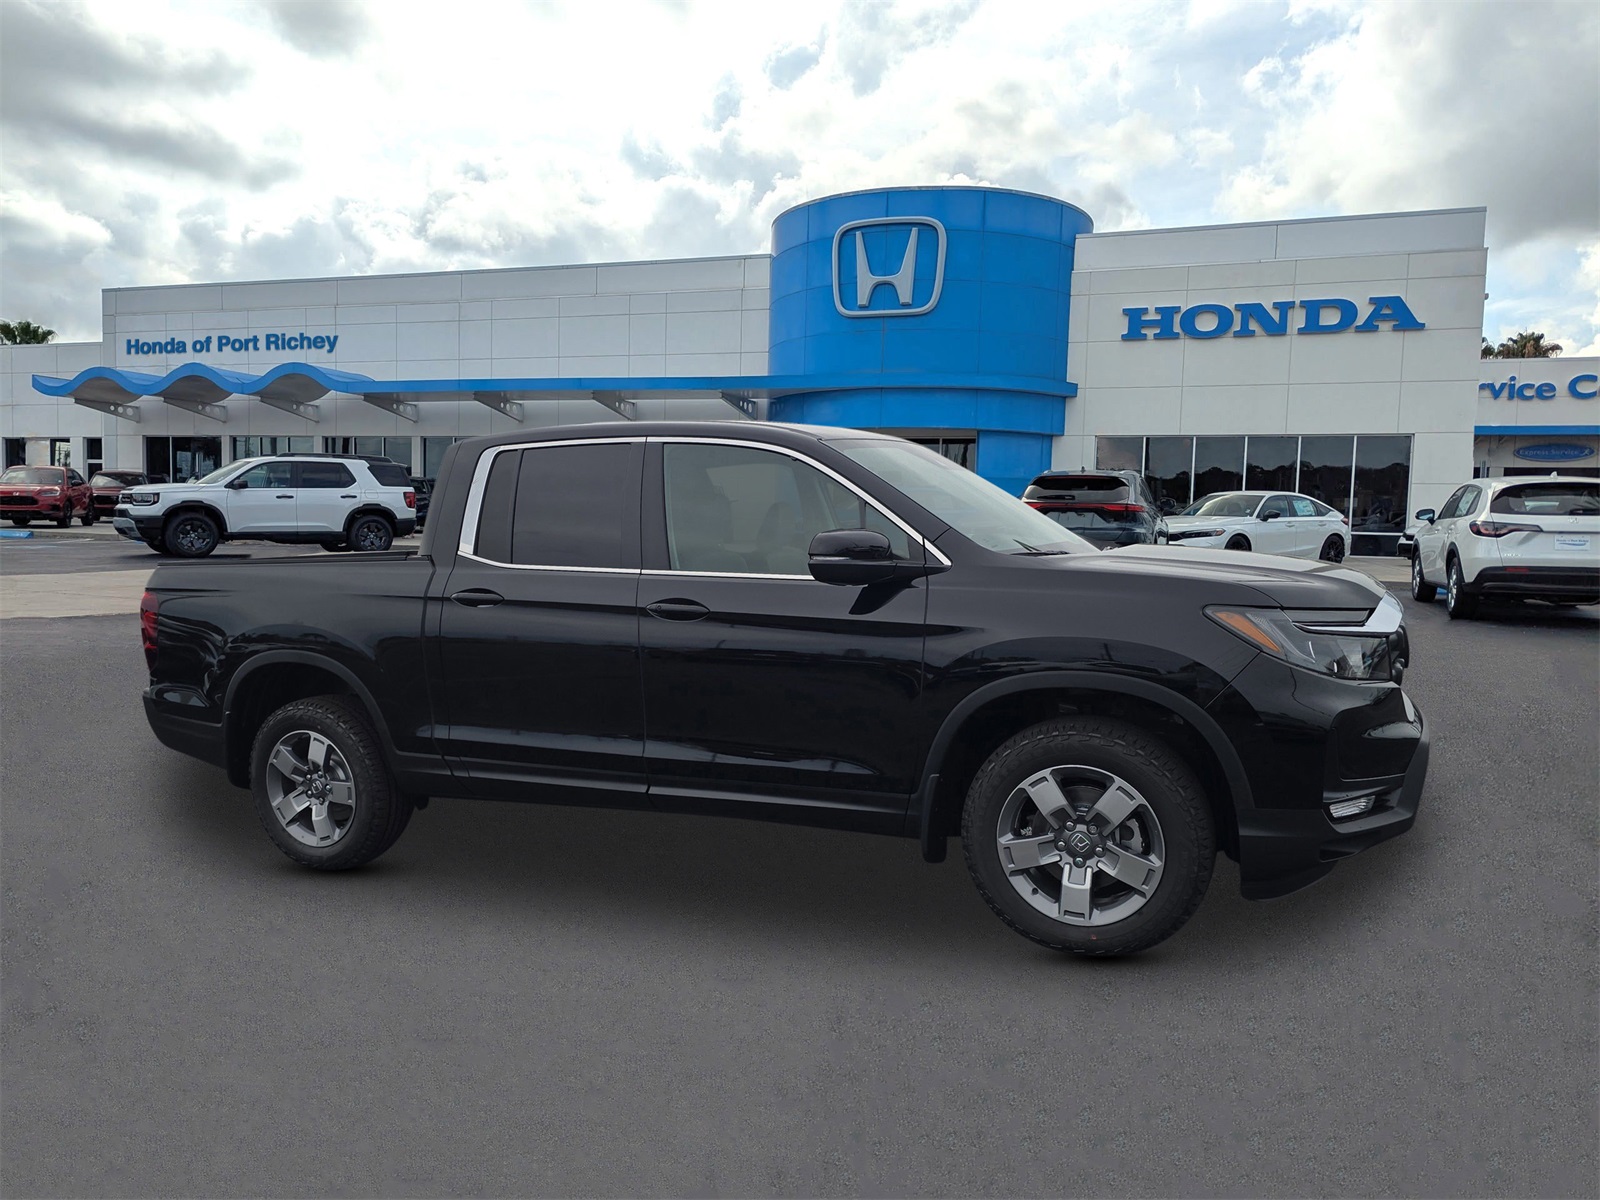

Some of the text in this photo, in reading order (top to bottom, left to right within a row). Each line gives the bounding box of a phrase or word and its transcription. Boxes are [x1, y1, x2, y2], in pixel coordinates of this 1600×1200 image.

[1121, 296, 1426, 340] HONDA
[126, 332, 339, 355] Honda of Port Richey
